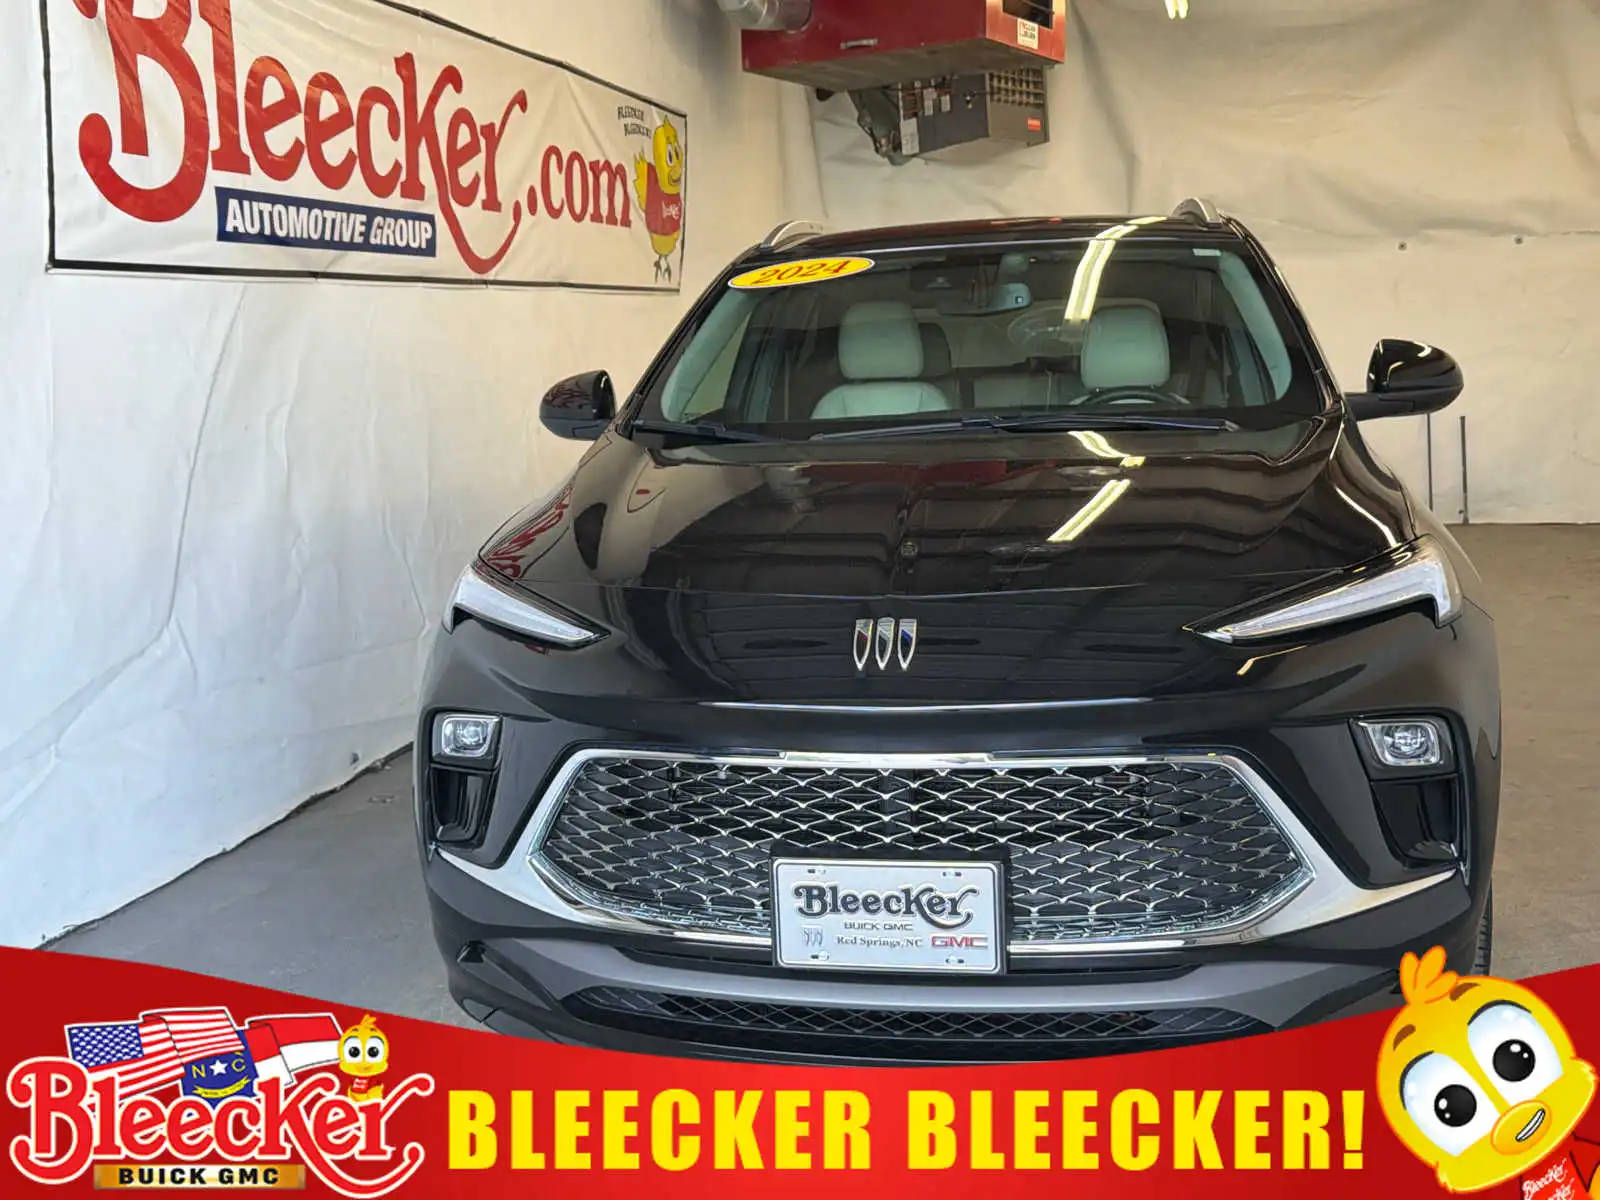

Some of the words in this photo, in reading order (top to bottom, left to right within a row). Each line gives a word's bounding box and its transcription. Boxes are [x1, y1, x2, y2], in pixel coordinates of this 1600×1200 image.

[225, 198, 367, 244] AUTOMOTIVE
[369, 215, 433, 250] GROUP
[752, 260, 851, 285] 2024
[794, 882, 979, 929] Bleecker
[843, 921, 880, 930] BUICK
[883, 922, 914, 931] GMC
[836, 935, 857, 945] Red
[931, 935, 989, 949] GMC
